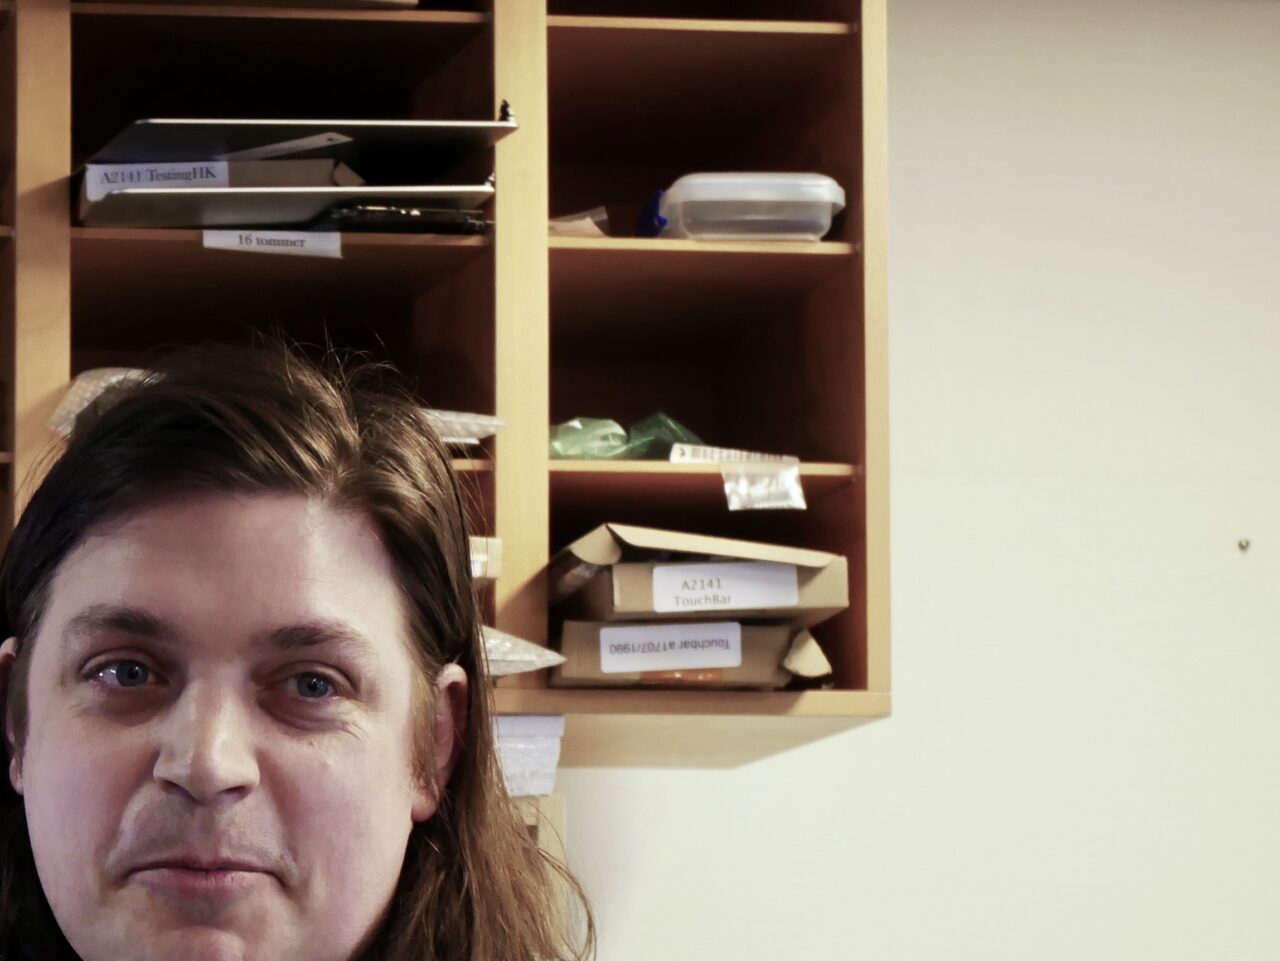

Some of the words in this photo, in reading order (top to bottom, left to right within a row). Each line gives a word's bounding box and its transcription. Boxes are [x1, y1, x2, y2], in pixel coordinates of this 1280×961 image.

[146, 167, 217, 182] TestingHK
[238, 234, 253, 246] 16
[256, 236, 306, 248] tommer
[681, 577, 723, 591] A2141
[674, 594, 732, 607] TouchBar
[679, 639, 731, 650] Touchbar
